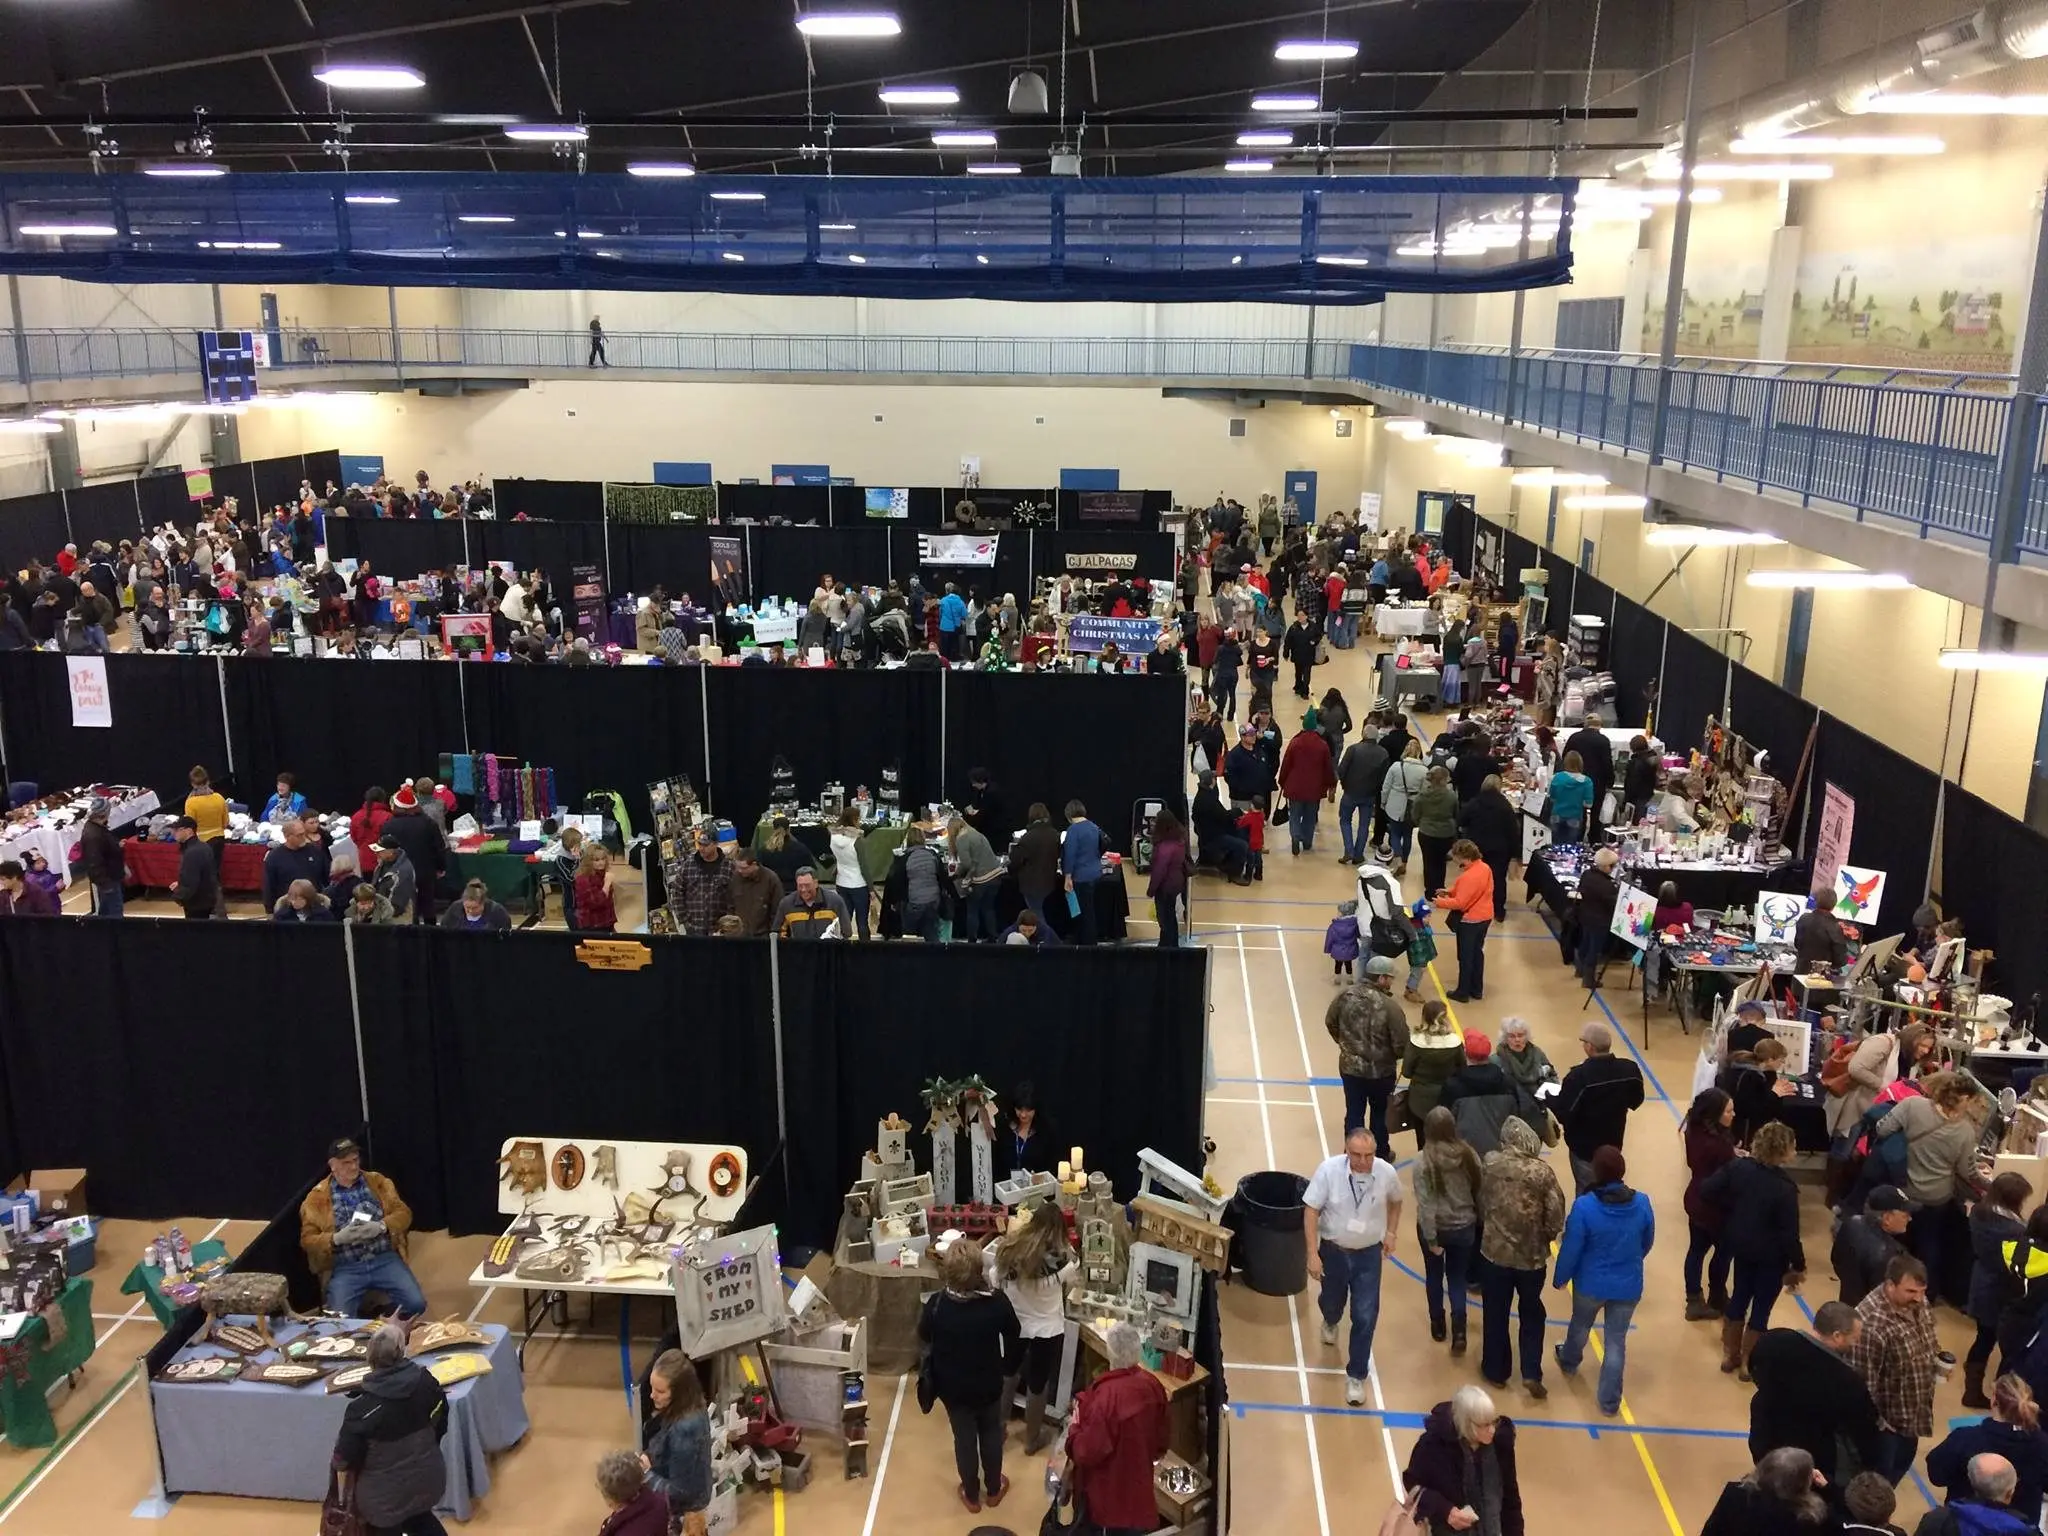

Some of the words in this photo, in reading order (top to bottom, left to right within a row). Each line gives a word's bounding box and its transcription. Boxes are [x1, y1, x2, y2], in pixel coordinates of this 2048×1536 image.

[1068, 556, 1082, 567] CJ
[1085, 556, 1133, 567] ALPACAS
[1080, 618, 1151, 630] COMMUNITY
[1072, 629, 1141, 640] CHRISTMAS
[703, 1261, 752, 1287] FROM
[718, 1281, 741, 1299] MY
[708, 1298, 756, 1321] SHED
